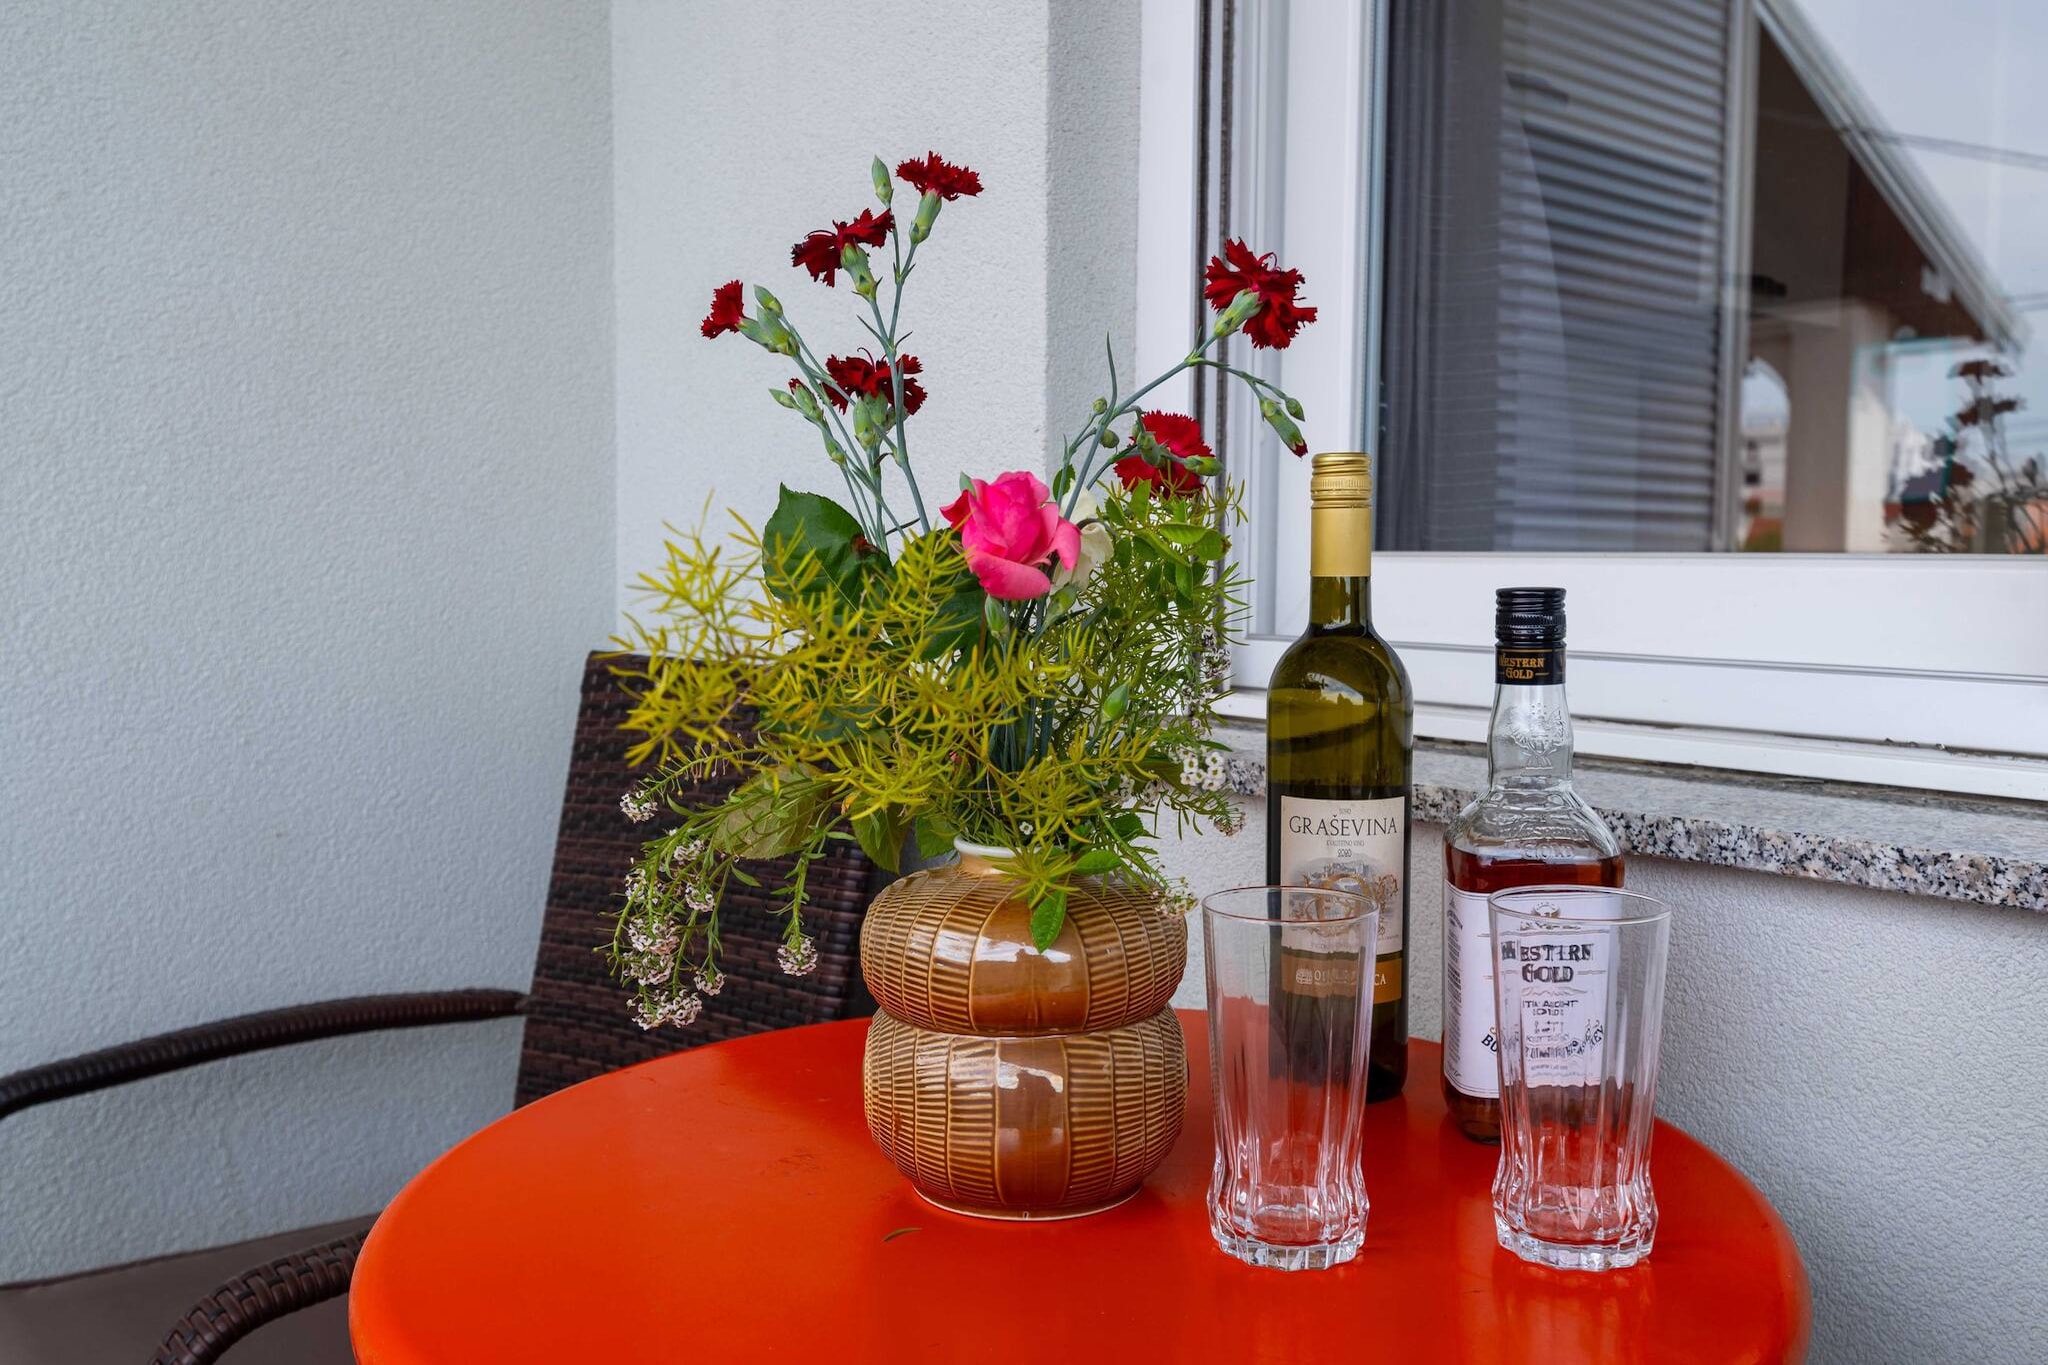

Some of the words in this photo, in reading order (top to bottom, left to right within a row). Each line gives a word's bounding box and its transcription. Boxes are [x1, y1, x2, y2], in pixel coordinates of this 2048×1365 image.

[1499, 654, 1544, 668] WESTERN
[1506, 667, 1534, 679] GOLD
[1289, 814, 1397, 836] GRAŠEVINA
[1522, 964, 1574, 983] GOLD
